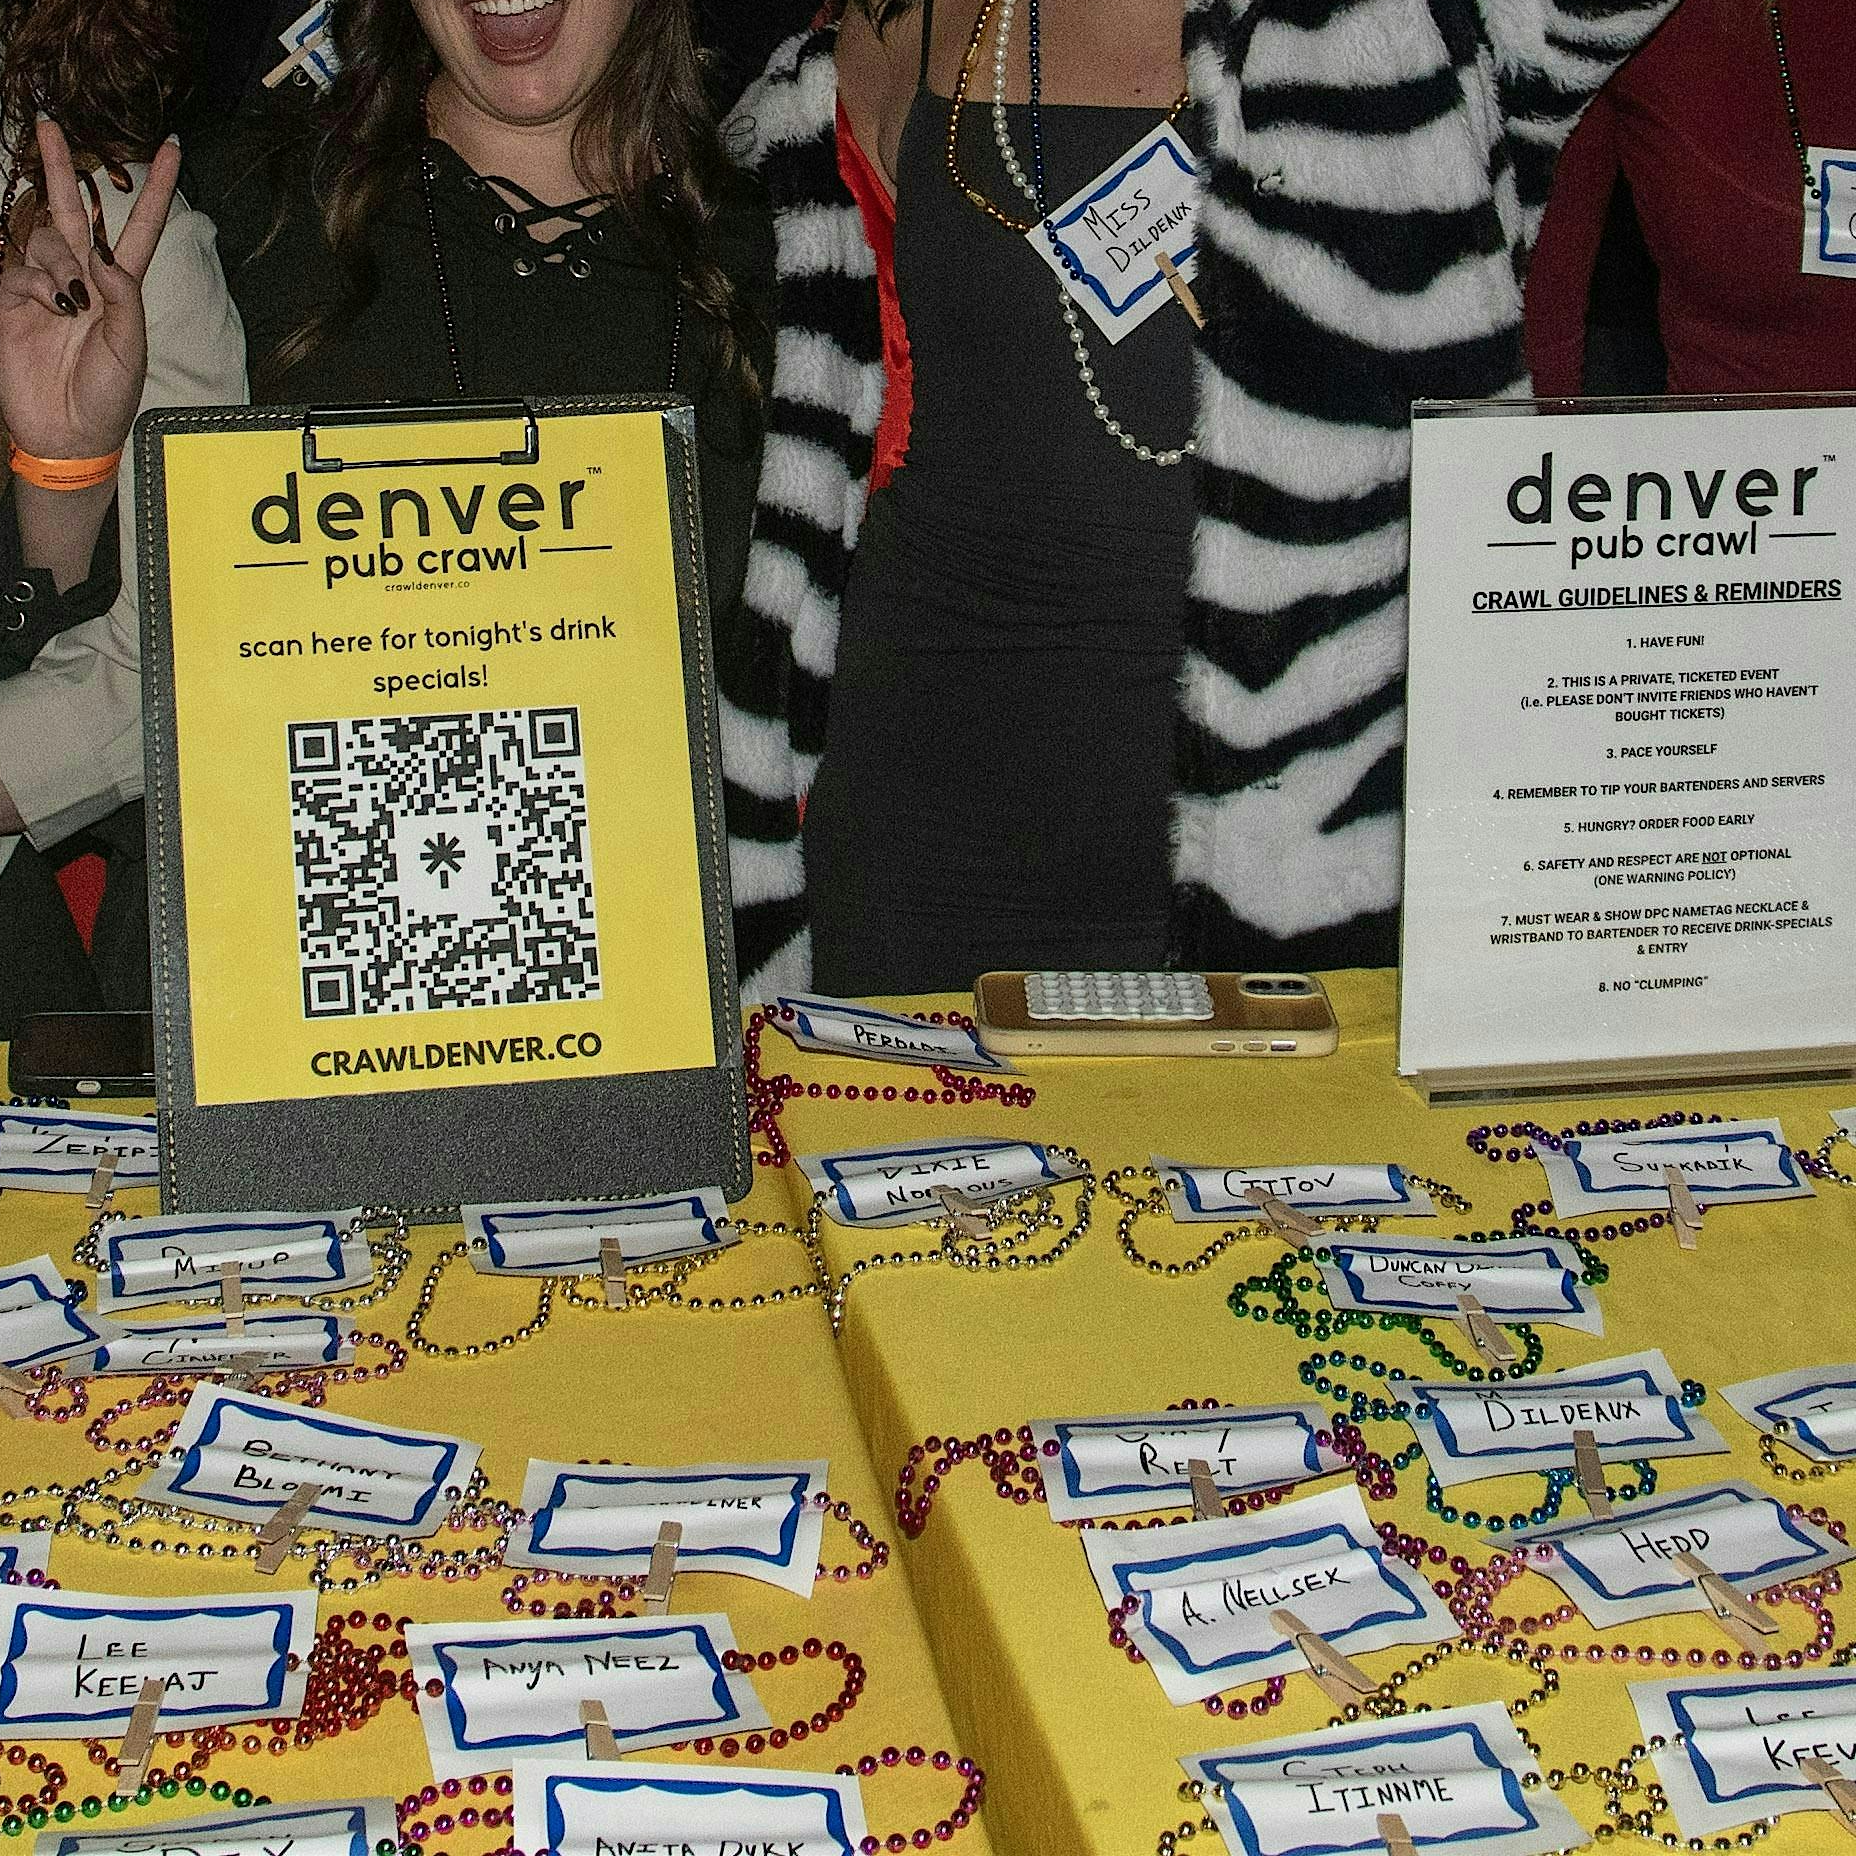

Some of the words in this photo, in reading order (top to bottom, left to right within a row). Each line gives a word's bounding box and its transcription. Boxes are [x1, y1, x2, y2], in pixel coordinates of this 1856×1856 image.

[1083, 189, 1151, 241] MISS
[1106, 202, 1192, 272] DILDEAUX
[251, 470, 585, 545] denver
[1506, 451, 1819, 525] denver
[325, 543, 403, 589] pub
[417, 536, 528, 573] crawl
[1571, 525, 1644, 570] pub
[1656, 521, 1757, 558] crawl
[384, 580, 470, 593] crawldenver.co
[1471, 589, 1552, 614] CRAWL
[1558, 584, 1687, 608] GUIDELINES
[1694, 584, 1708, 604] &
[1715, 579, 1842, 602] REMINDERS
[239, 634, 303, 659] scan
[311, 631, 373, 654] here
[380, 627, 417, 650] for
[424, 619, 543, 652] tonight's
[550, 616, 617, 641] drink
[1626, 638, 1637, 649] 1.
[1640, 636, 1673, 649] HAVE
[1675, 635, 1705, 647] FUN!
[373, 666, 489, 699] specials!
[1564, 822, 1575, 834] 5.
[1578, 819, 1636, 834] HUNGRY?
[1639, 816, 1679, 831] ORDER
[1683, 815, 1715, 829] FOOD
[1718, 813, 1755, 827] EARLY
[310, 1031, 603, 1079] CRAWLDENVER.CO
[1484, 1401, 1641, 1432] DILDEAUX
[1181, 1593, 1214, 1627] A.
[1222, 1567, 1351, 1612] NELLSEX
[77, 1634, 149, 1659] LEE
[584, 1651, 680, 1672] NEEZ
[1297, 1778, 1455, 1814] ITINNME
